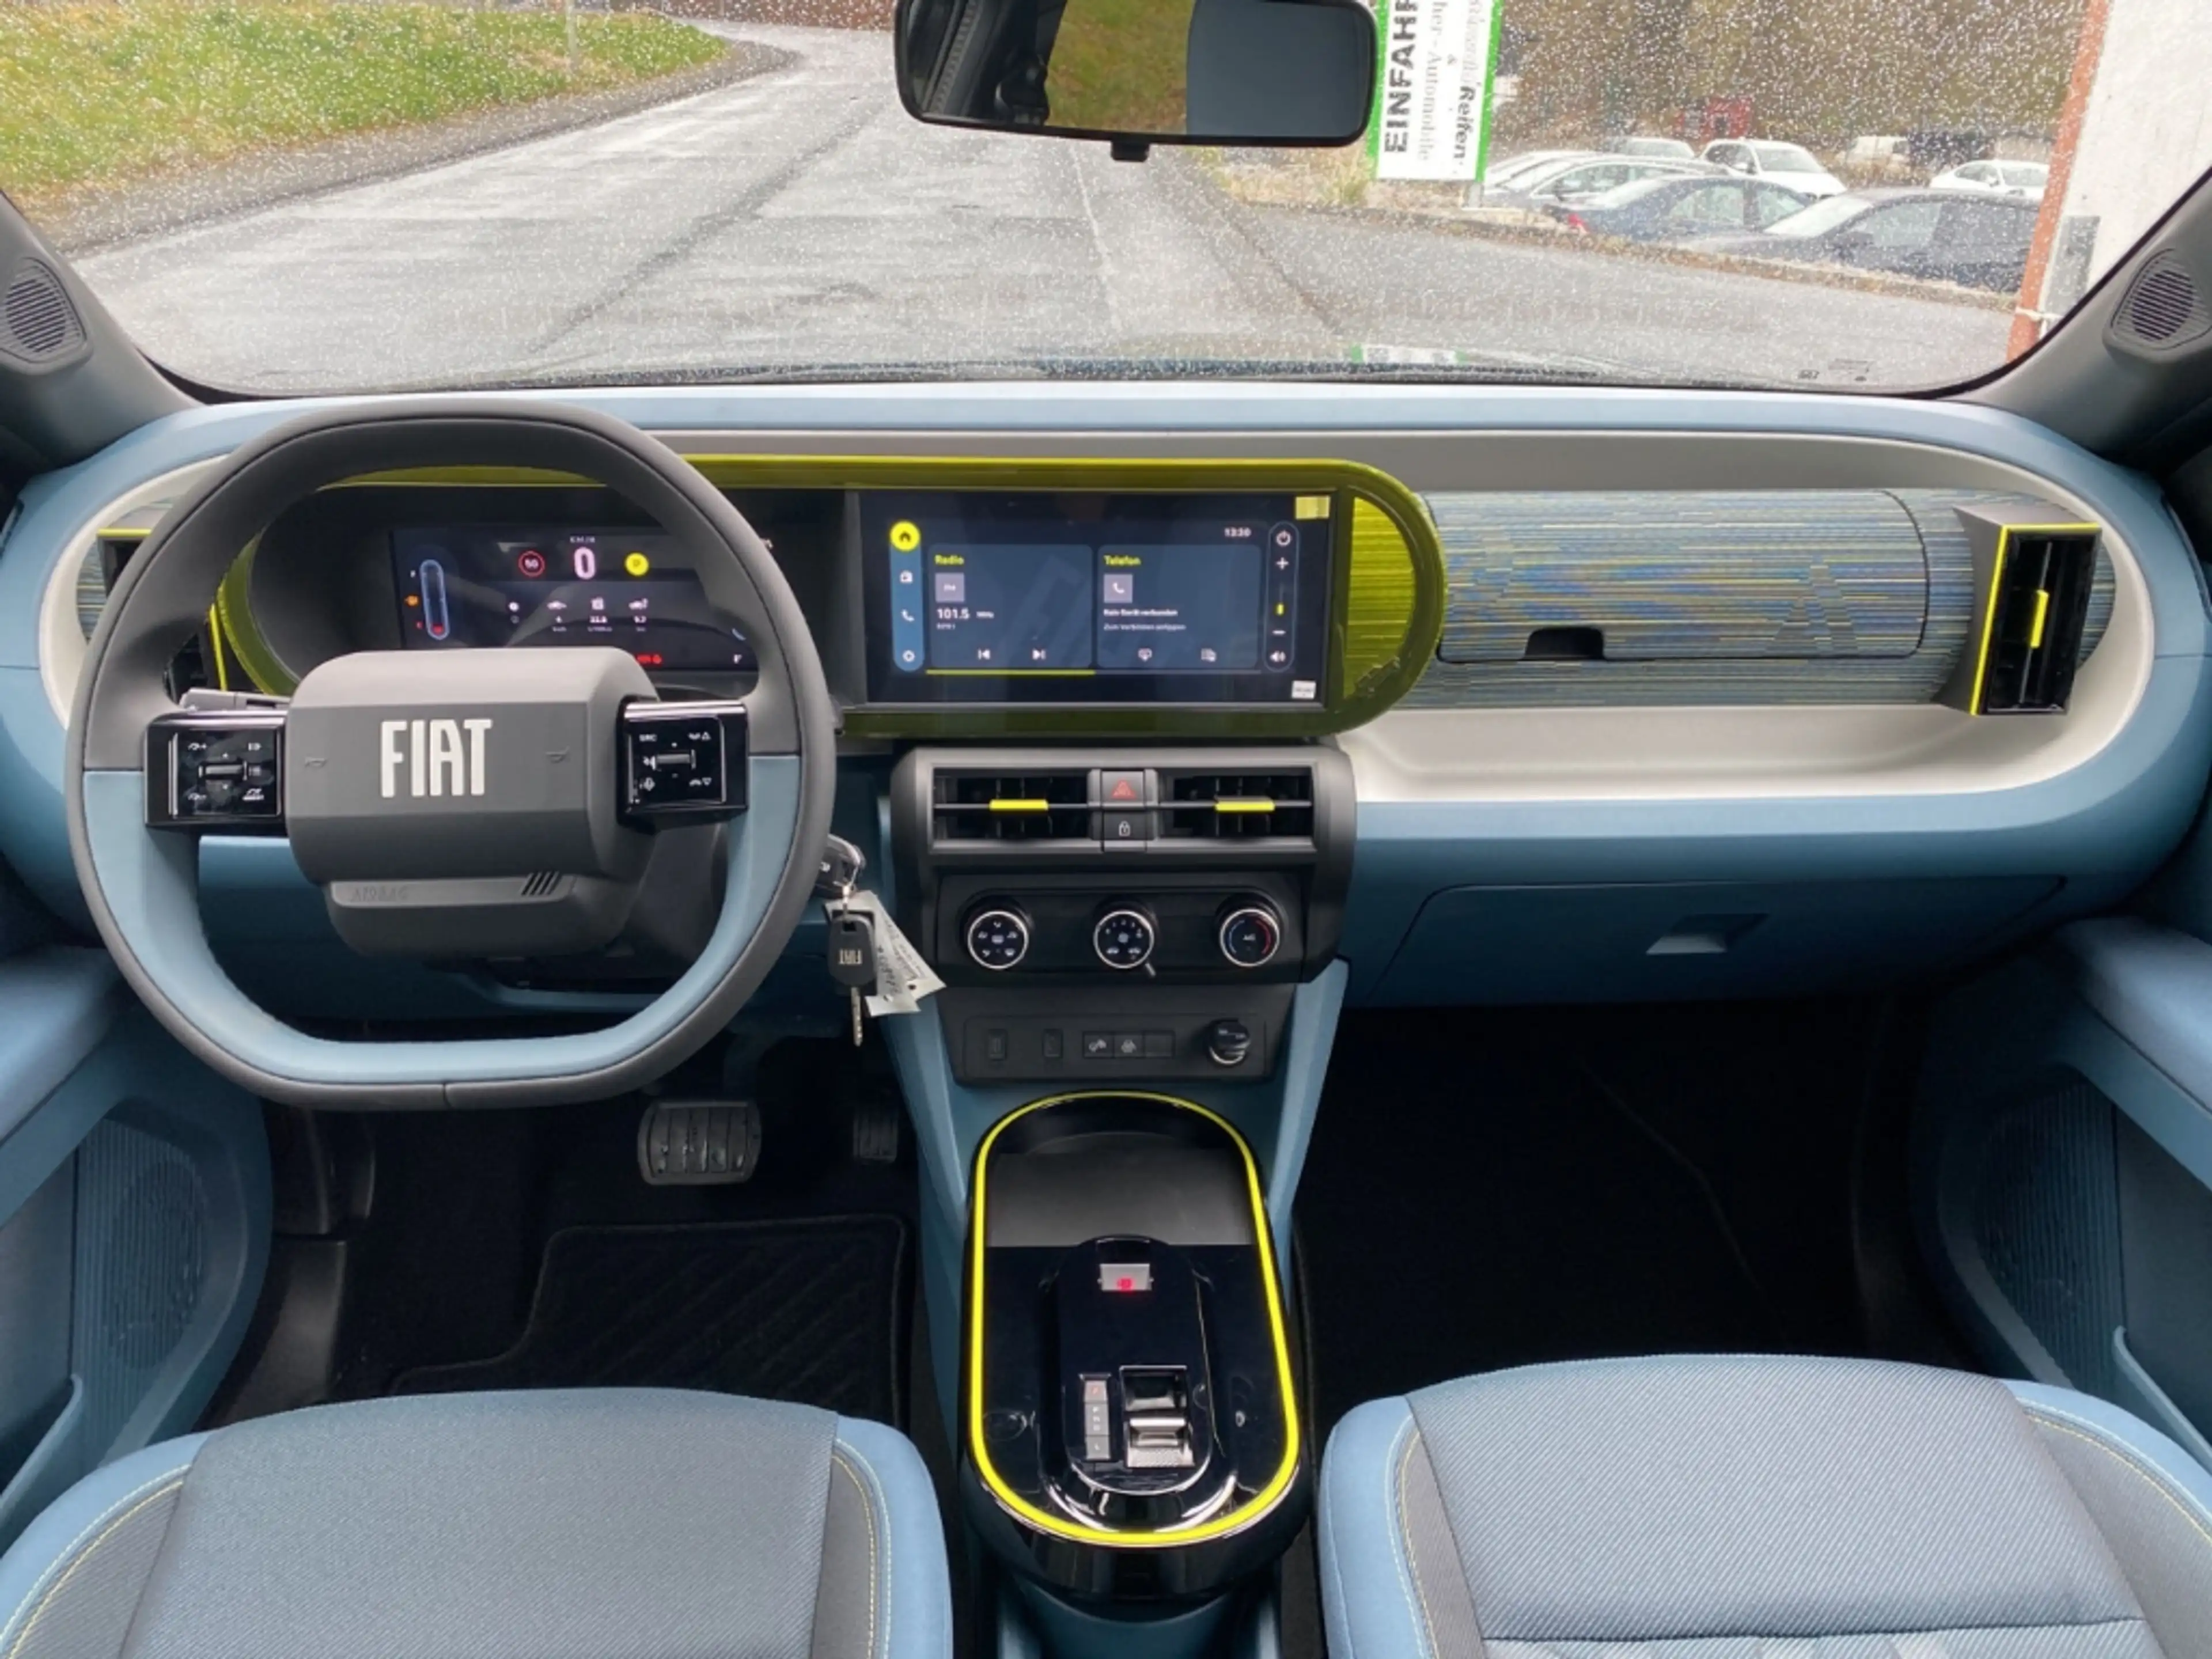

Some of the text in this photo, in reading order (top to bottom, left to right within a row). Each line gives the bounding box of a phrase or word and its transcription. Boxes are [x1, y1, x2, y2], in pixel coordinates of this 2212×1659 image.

[1454, 86, 1475, 158] Reifen
[574, 547, 595, 579] 0
[935, 554, 964, 565] Radio
[1103, 555, 1141, 566] Telefon
[937, 608, 970, 620] 101.5
[381, 719, 493, 798] FIAT
